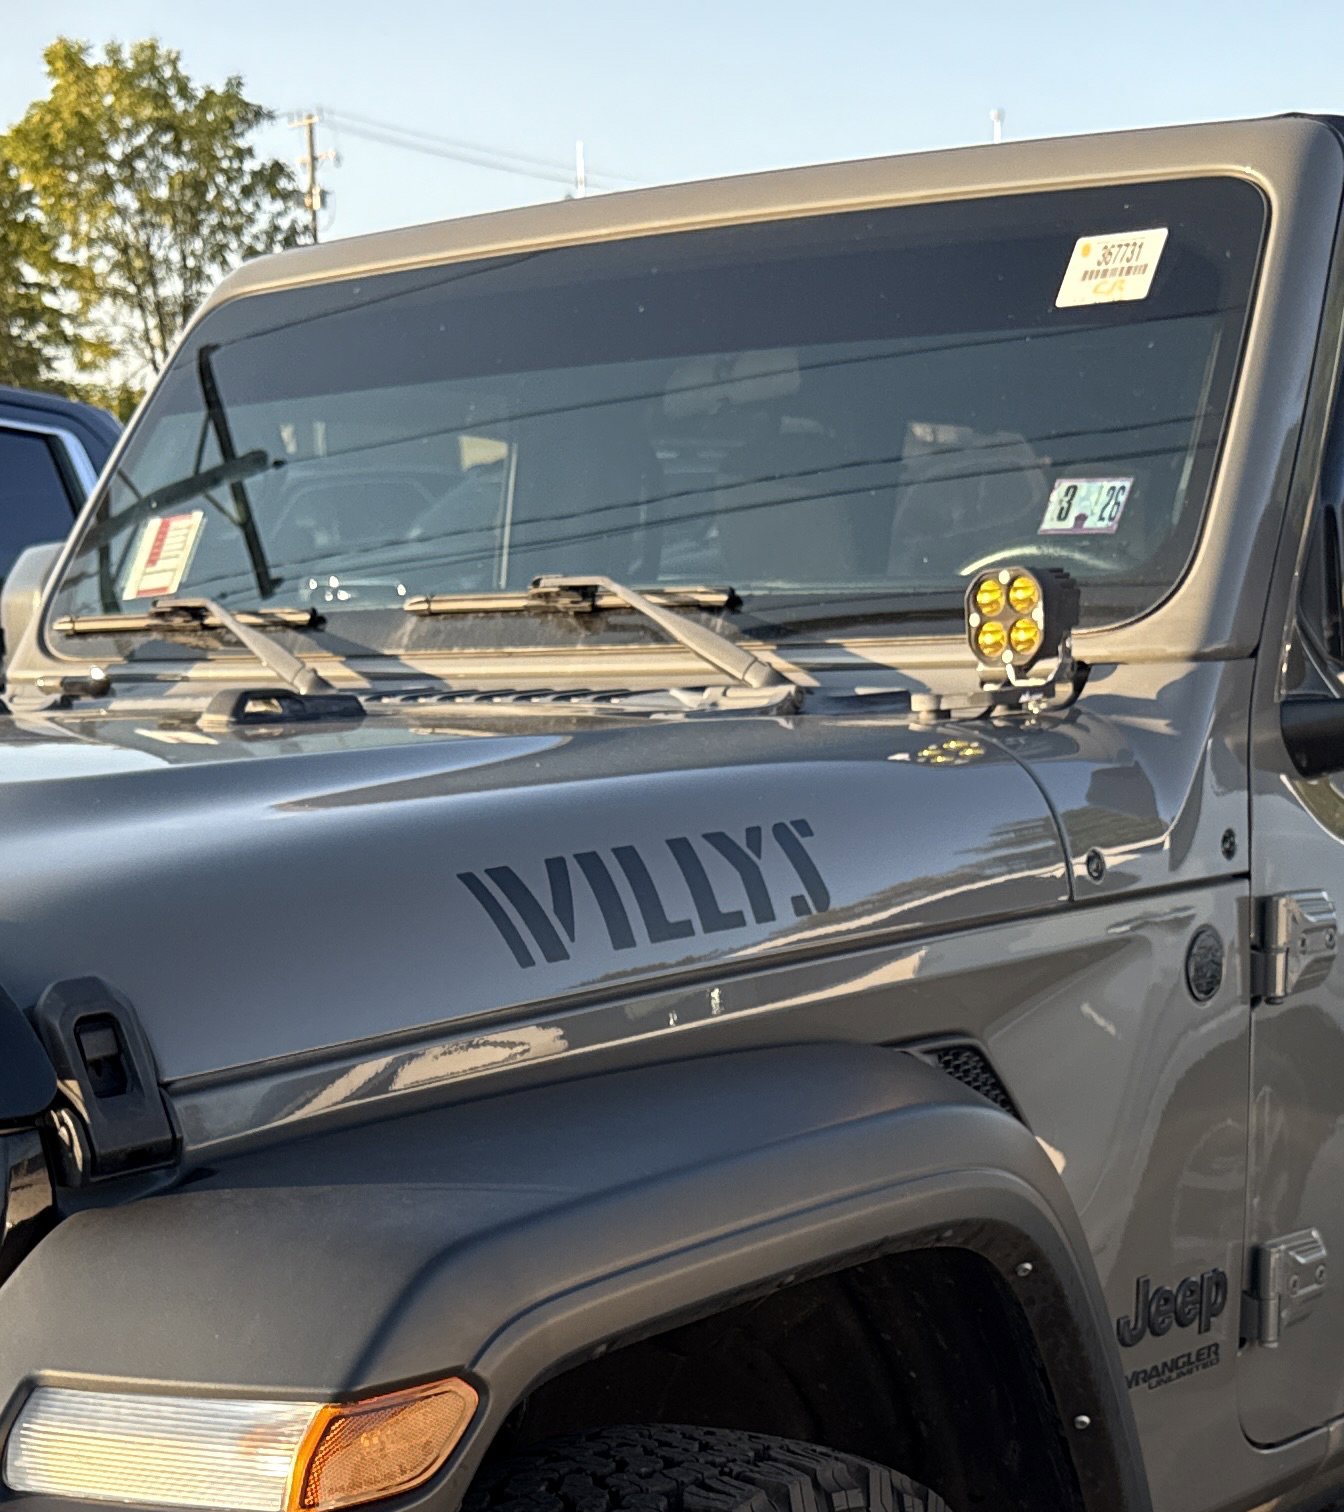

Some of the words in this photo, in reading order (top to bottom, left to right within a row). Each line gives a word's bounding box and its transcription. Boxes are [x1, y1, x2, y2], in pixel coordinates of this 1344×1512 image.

[1096, 241, 1145, 267] 367731
[1056, 484, 1077, 522] 3
[1098, 485, 1126, 521] 26
[456, 818, 831, 969] WILLYS
[1116, 1267, 1228, 1348] Jeep
